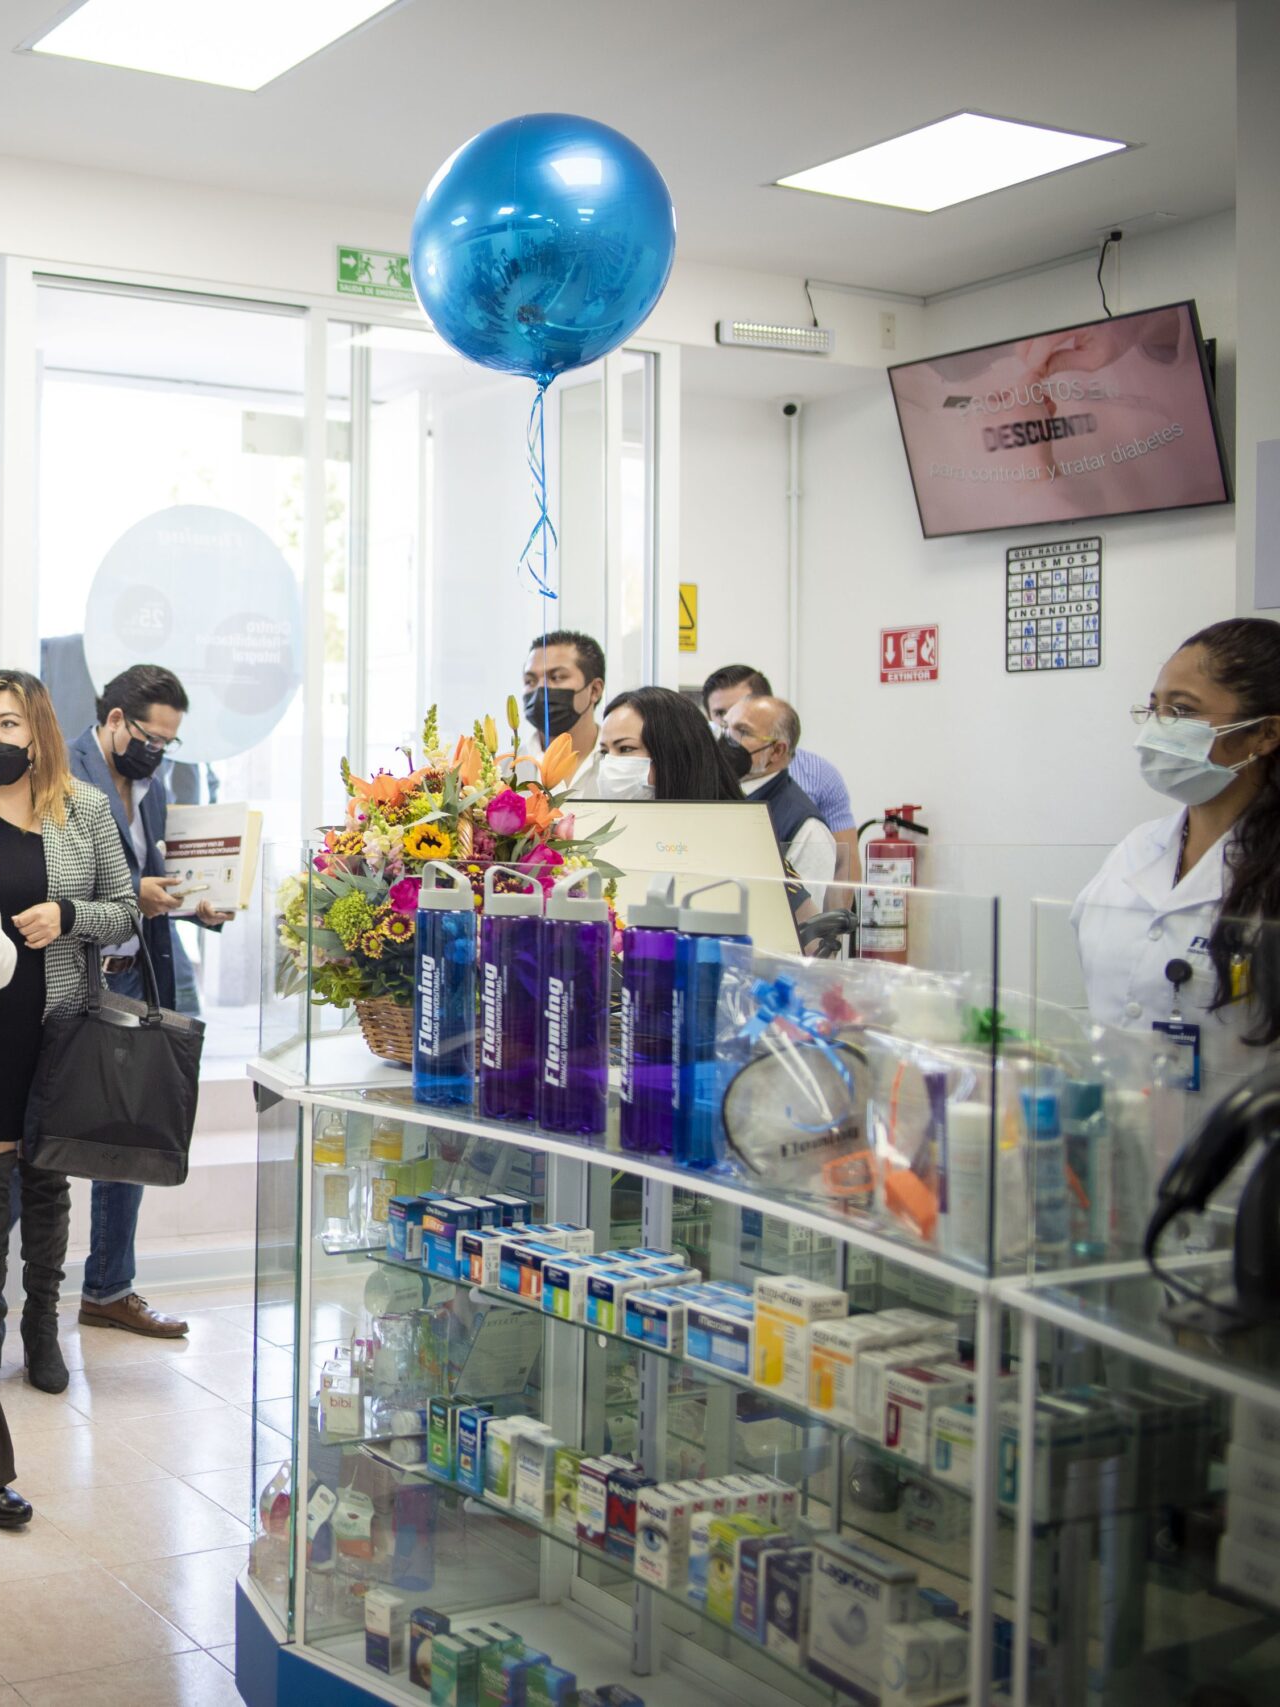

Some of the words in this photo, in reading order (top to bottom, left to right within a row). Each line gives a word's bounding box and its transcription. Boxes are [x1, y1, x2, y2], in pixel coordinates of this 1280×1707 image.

[956, 380, 1085, 418] PRODUCTOS
[982, 412, 1098, 453] DESCUENTO
[928, 462, 966, 479] para
[970, 463, 1041, 482] controlar
[1047, 464, 1056, 482] y
[1061, 453, 1106, 475] tratar
[1111, 422, 1185, 464] diabetes
[1014, 548, 1033, 559] QUE
[1019, 554, 1088, 571] SISMOS
[1013, 602, 1093, 619] INCENDIOS
[887, 670, 930, 682] EXTINTOR
[655, 841, 689, 856] Google
[418, 954, 436, 1056] Fleming
[481, 962, 498, 1069] Fleming
[544, 976, 564, 1087] Fleming
[715, 1498, 725, 1508] N
[738, 1497, 748, 1507] N
[758, 1493, 768, 1503] N
[783, 1492, 794, 1502] N
[639, 1500, 667, 1520] Nazil
[674, 1506, 685, 1516] N
[693, 1502, 704, 1512] N
[817, 1554, 880, 1600] Lagricel
